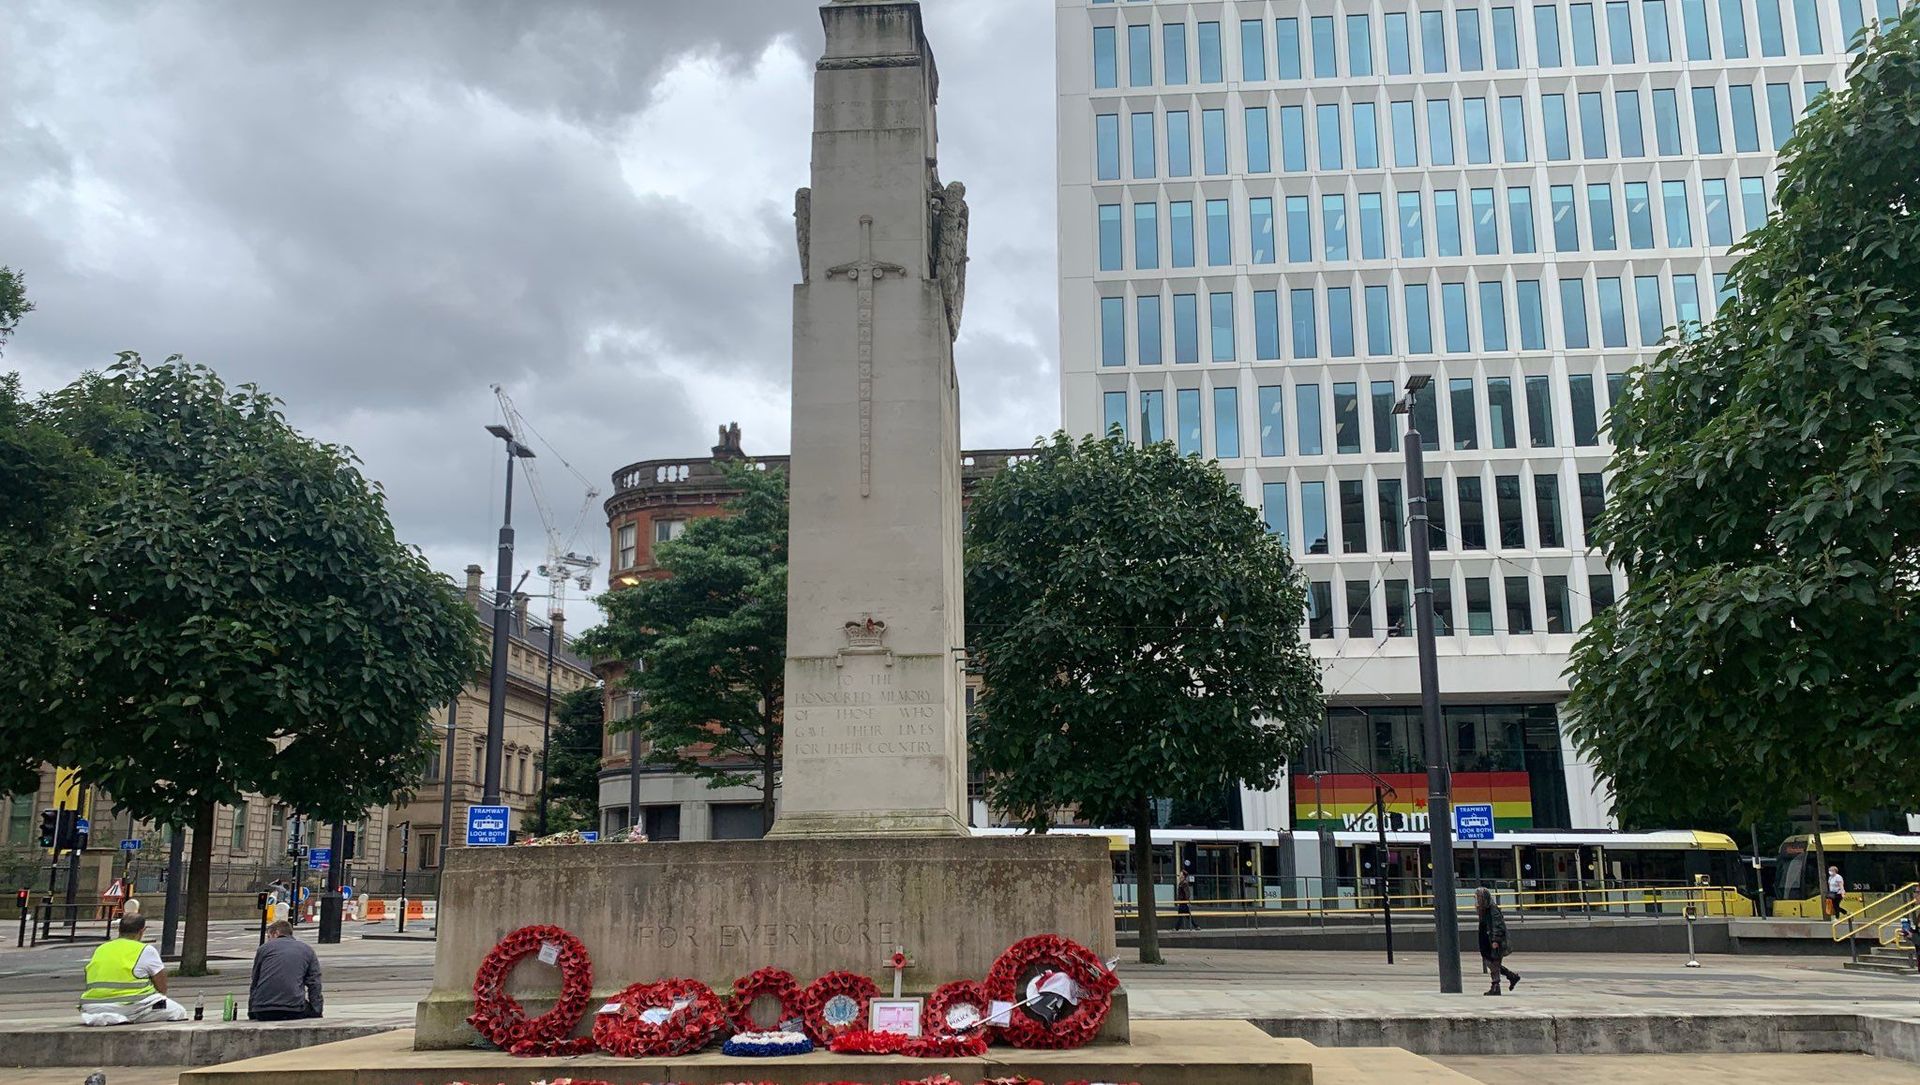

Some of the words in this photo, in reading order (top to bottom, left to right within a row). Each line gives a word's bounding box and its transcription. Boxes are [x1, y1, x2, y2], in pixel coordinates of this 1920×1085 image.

[837, 674, 851, 686] TO
[869, 673, 892, 685] THE
[794, 710, 808, 721] OF
[837, 708, 877, 720] THOSE
[900, 707, 935, 718] WHO
[794, 726, 826, 738] GAVE
[845, 725, 884, 737] THEIR
[900, 724, 935, 736] LIVES
[795, 743, 819, 755] FOR
[827, 742, 864, 755] THEIR
[638, 926, 699, 948] FOR
[719, 921, 895, 947] EVERMORE
